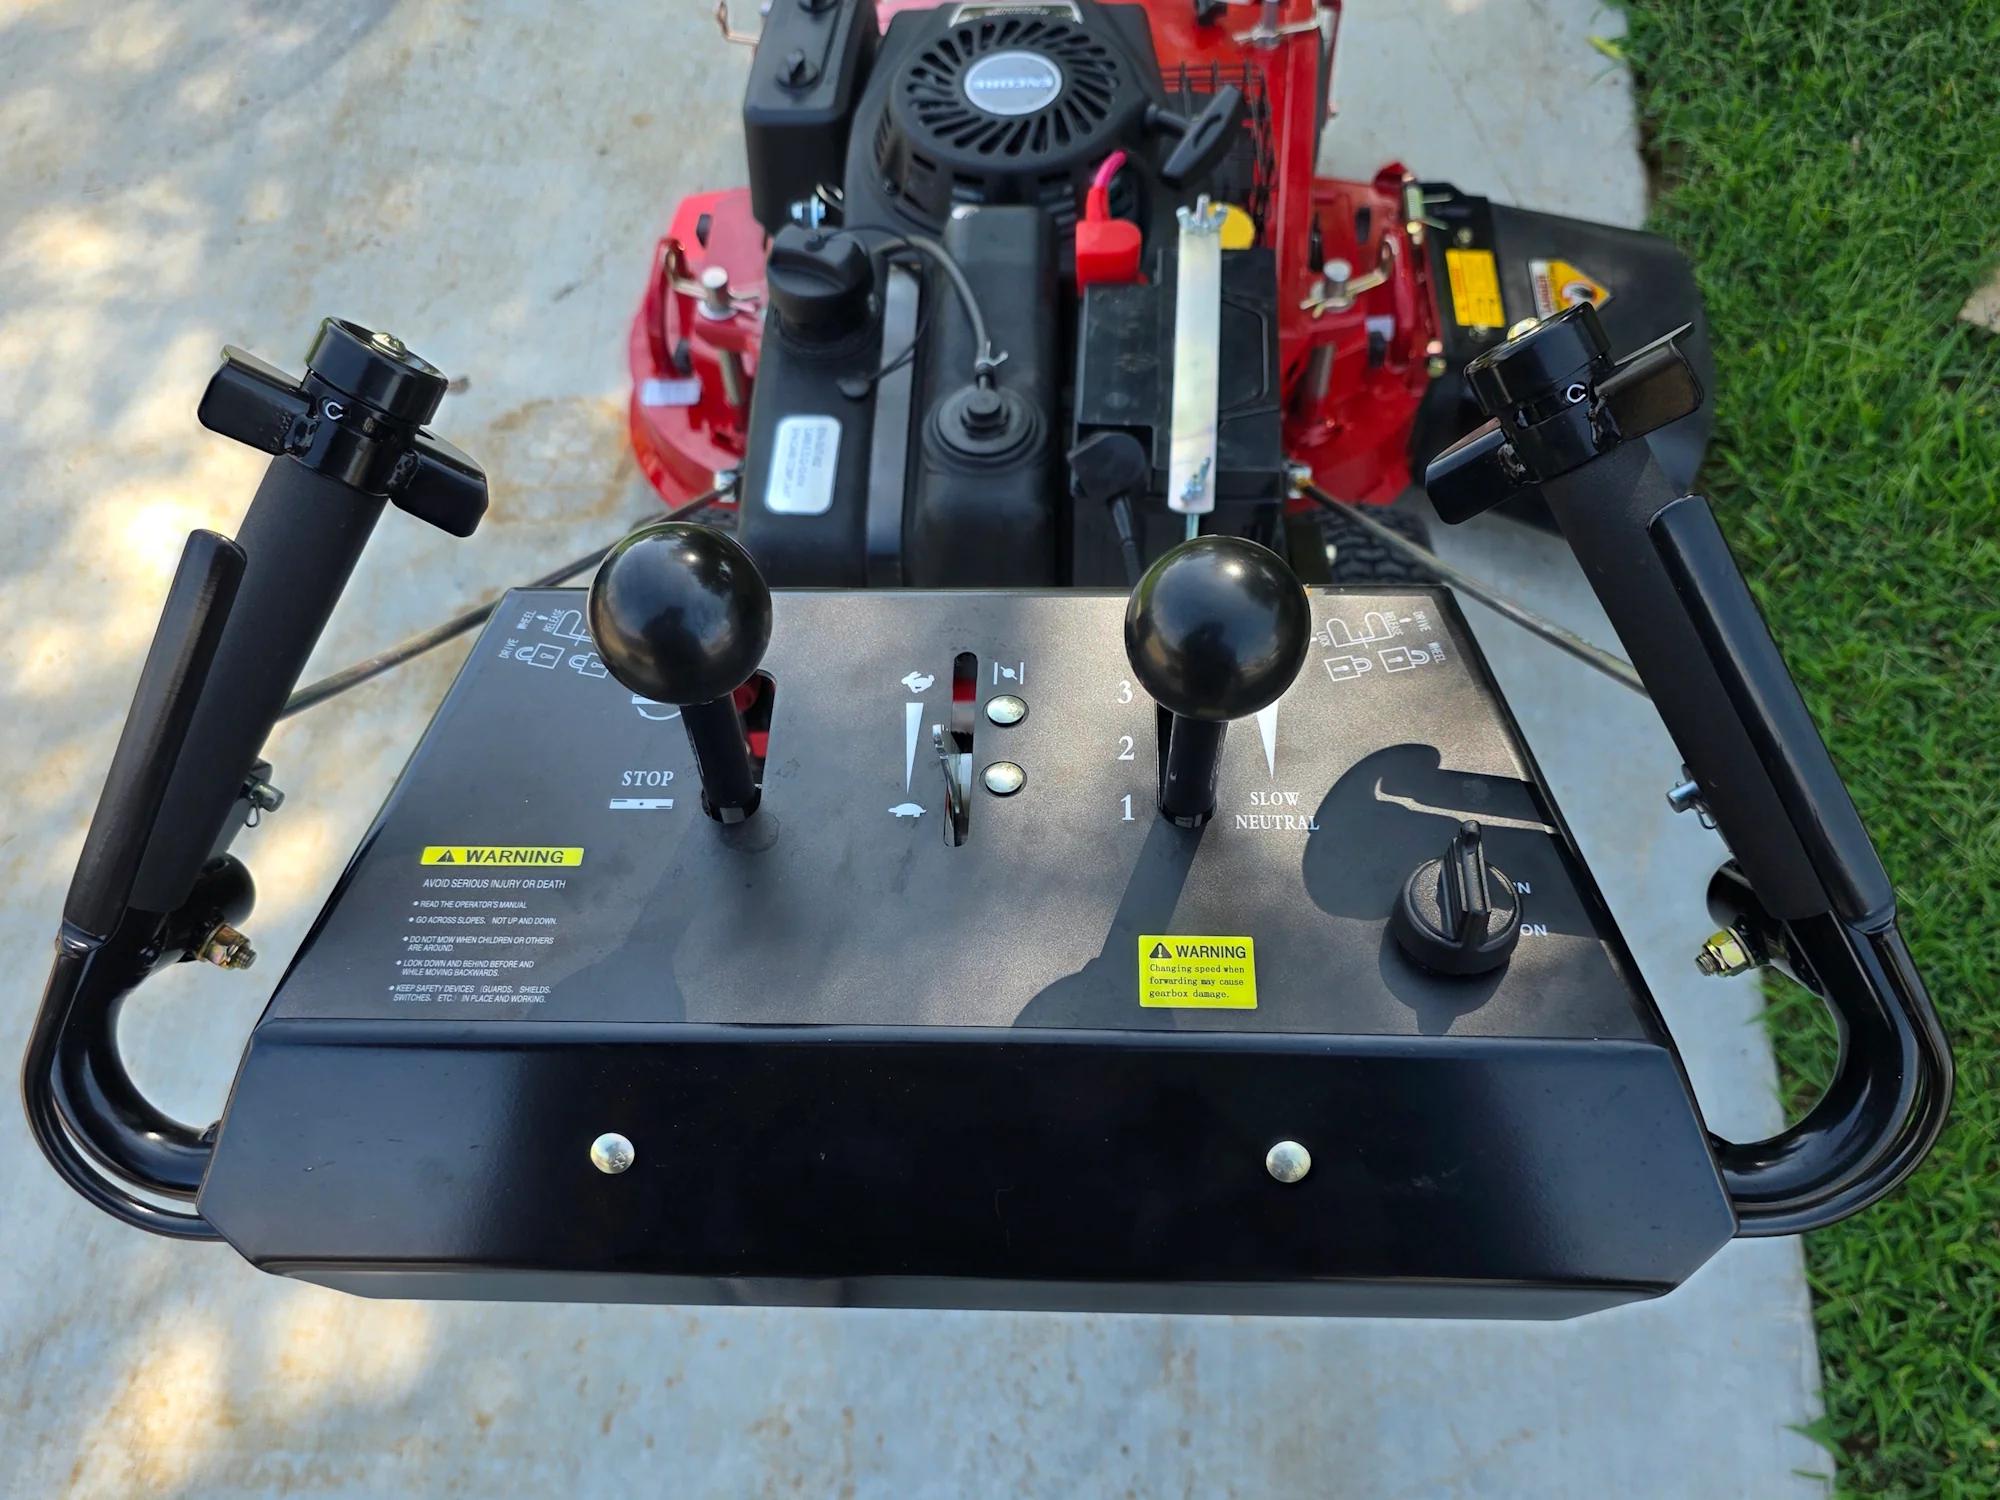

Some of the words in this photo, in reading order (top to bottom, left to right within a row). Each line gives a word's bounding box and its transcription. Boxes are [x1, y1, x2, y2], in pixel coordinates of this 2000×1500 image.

[516, 610, 536, 630] WHEEL
[543, 608, 564, 632] RELEASE
[1384, 612, 1404, 636] RELEASE
[1413, 611, 1432, 632] DRIVE
[498, 638, 519, 658] DRIVE
[1316, 630, 1330, 648] LOCK
[1428, 642, 1446, 663] WHEEL
[1117, 680, 1133, 704] 3
[1117, 736, 1134, 760] 2
[622, 771, 674, 786] STOP
[1120, 794, 1135, 820] 1
[1250, 792, 1300, 806] SLOW
[1236, 814, 1320, 830] NEUTRAL
[466, 850, 564, 864] WARNING
[423, 879, 450, 888] AVOID
[451, 879, 488, 888] SERIOUS
[490, 880, 522, 888] INJURY
[522, 880, 536, 888] OR
[537, 880, 566, 888] DEATH
[1176, 945, 1246, 958] WARNING
[1150, 964, 1192, 974] Changing
[1195, 965, 1220, 974] speed
[1150, 977, 1198, 986] forwarding
[1150, 990, 1188, 998] gearbox
[1193, 990, 1230, 998] damage.
